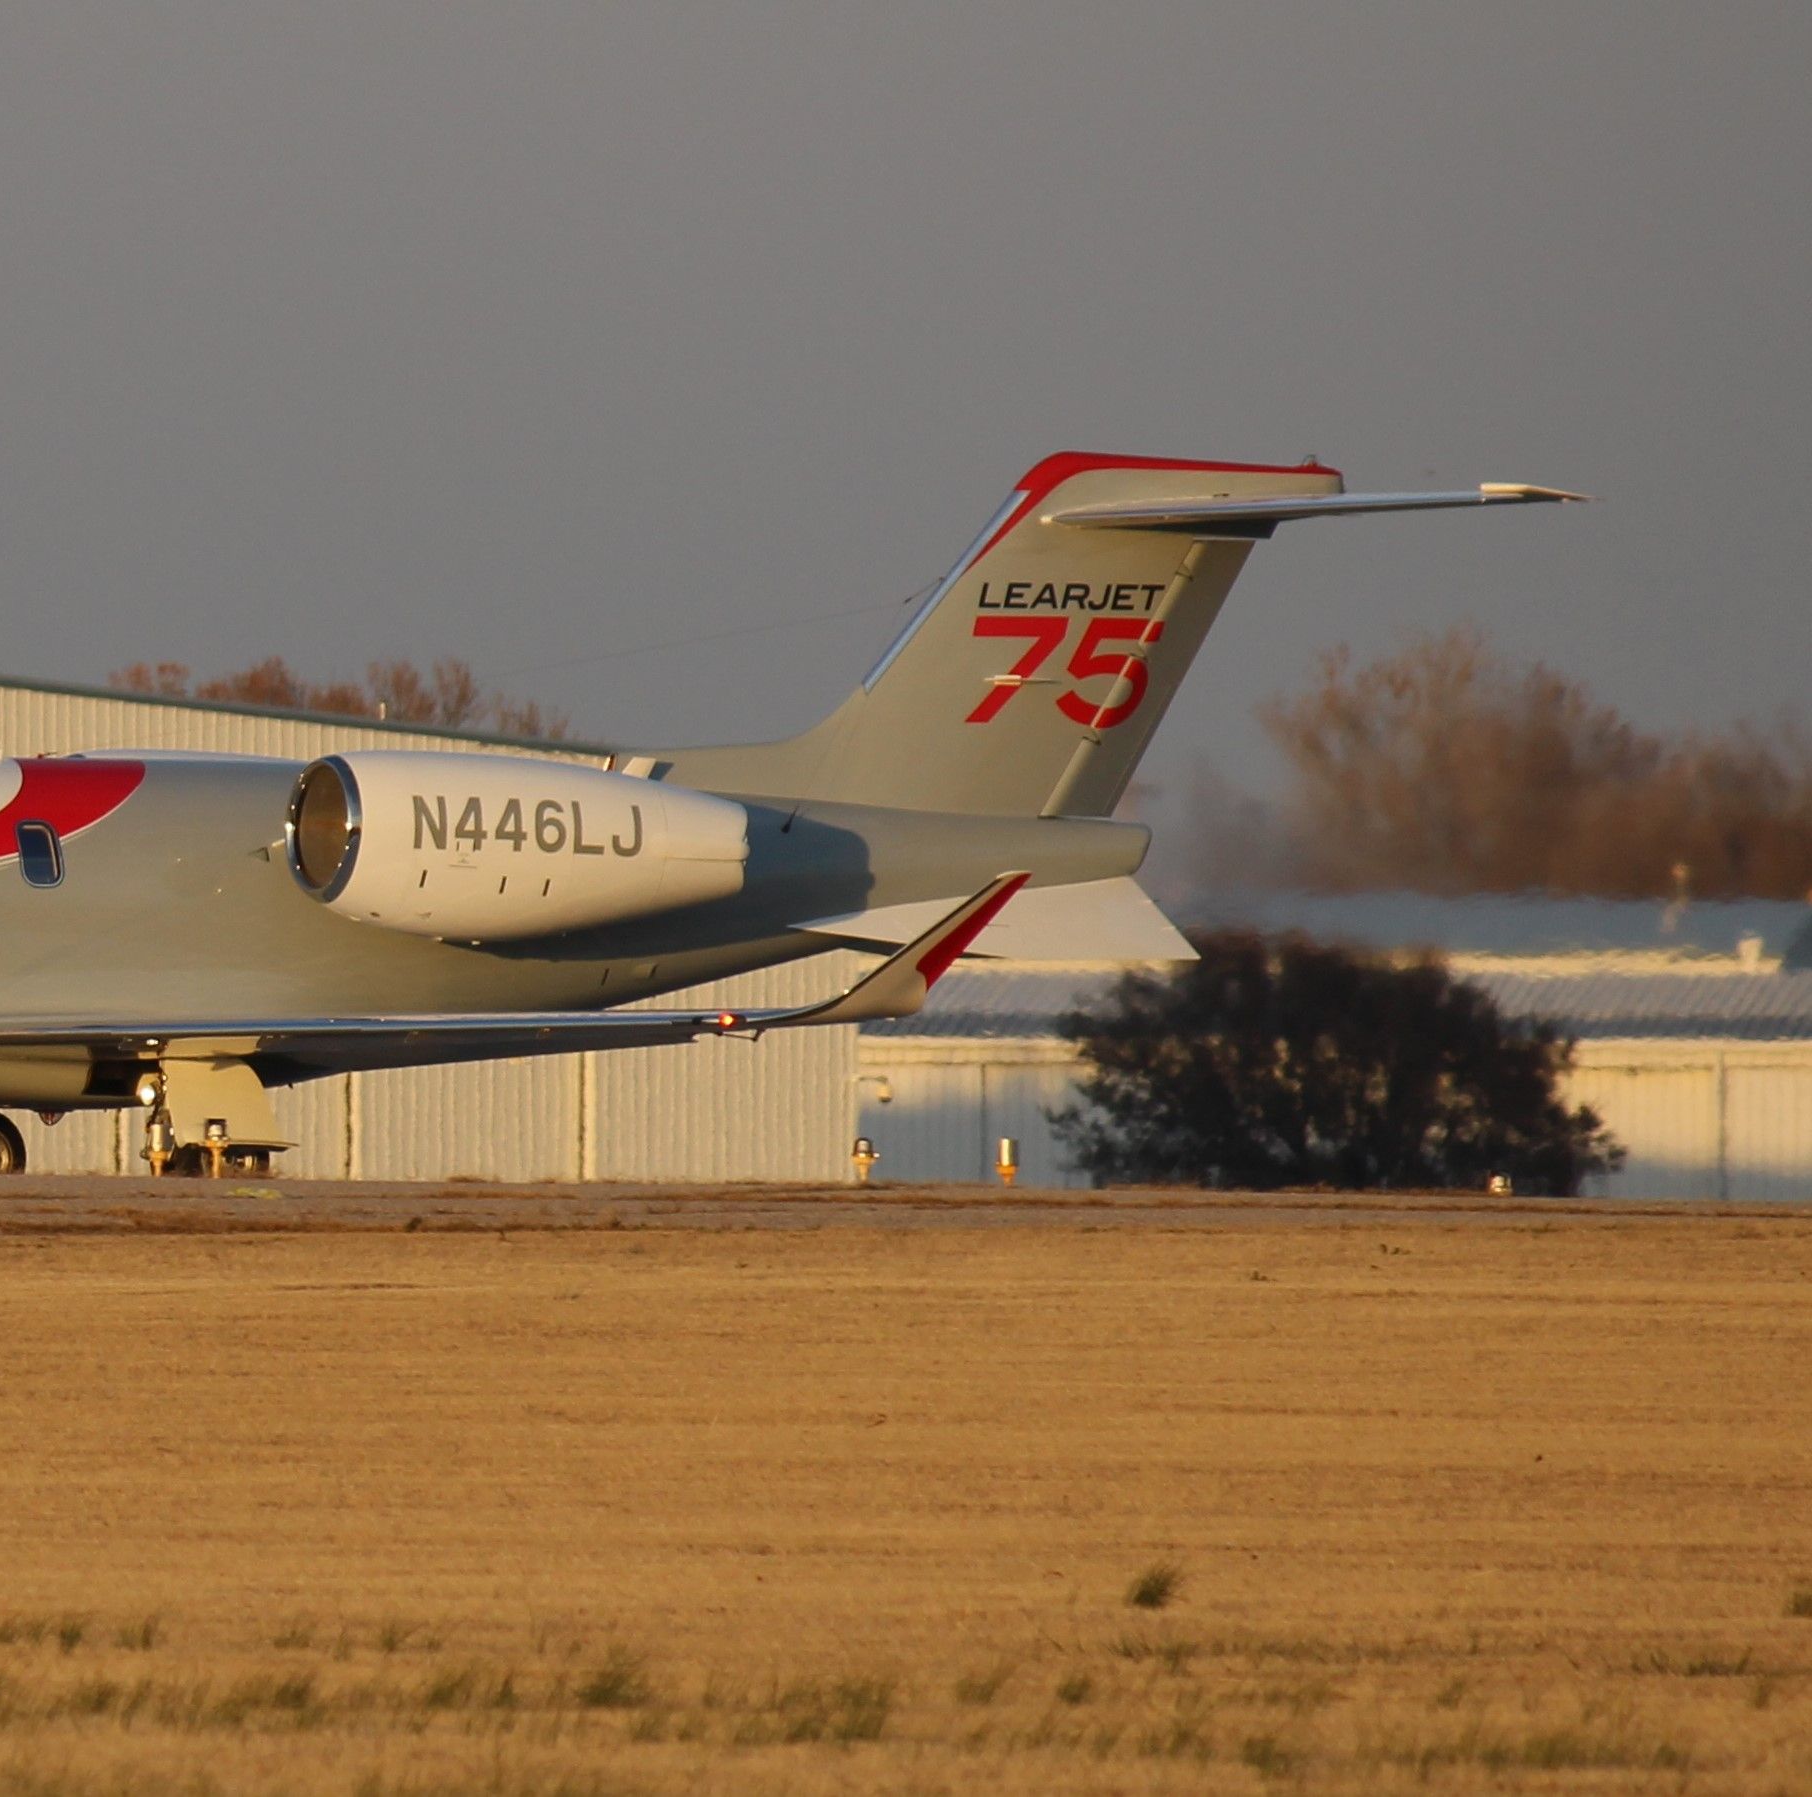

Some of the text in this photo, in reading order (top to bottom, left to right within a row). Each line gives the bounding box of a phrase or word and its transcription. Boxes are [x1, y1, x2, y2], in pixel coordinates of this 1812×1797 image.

[978, 582, 1166, 611] LEARJET
[965, 615, 1166, 730] 75
[412, 795, 644, 858] N446LJ
